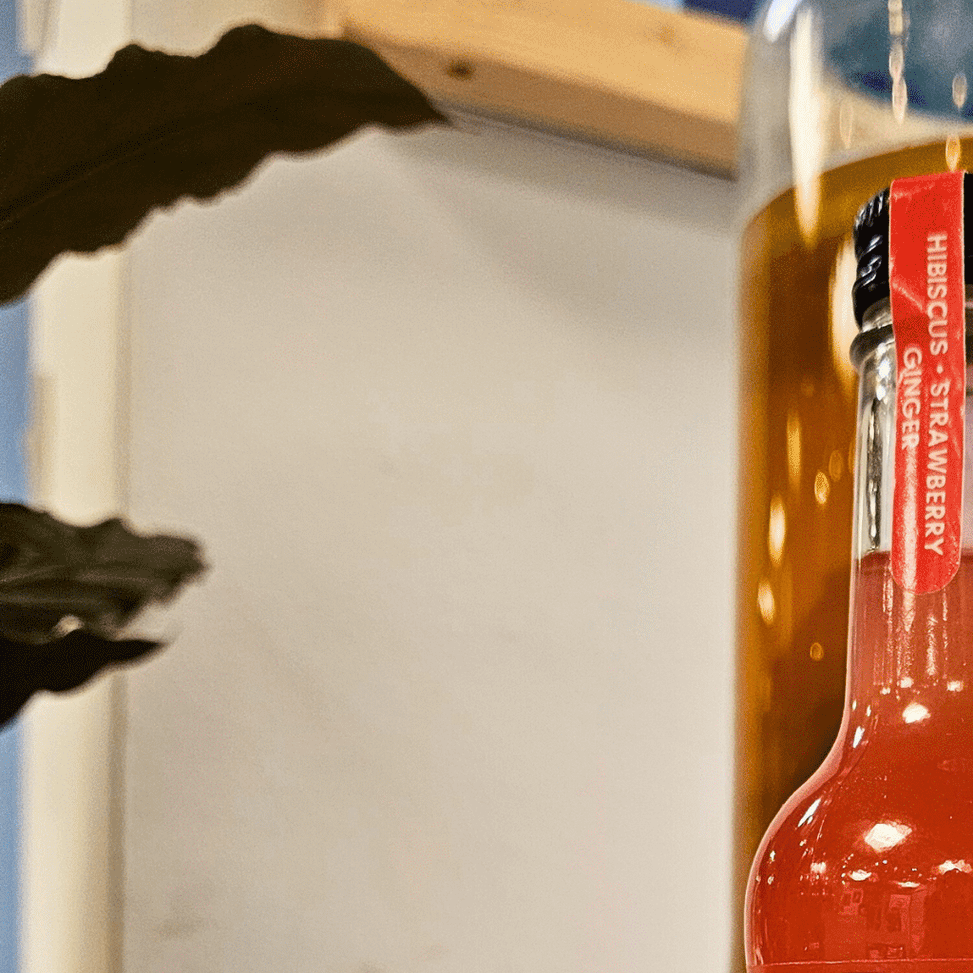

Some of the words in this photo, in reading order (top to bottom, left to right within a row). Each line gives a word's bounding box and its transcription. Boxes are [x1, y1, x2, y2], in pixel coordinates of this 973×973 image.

[927, 231, 949, 356] HIBISCUS
[902, 346, 923, 450] GINGER
[924, 378, 951, 556] STRAWBERRY
